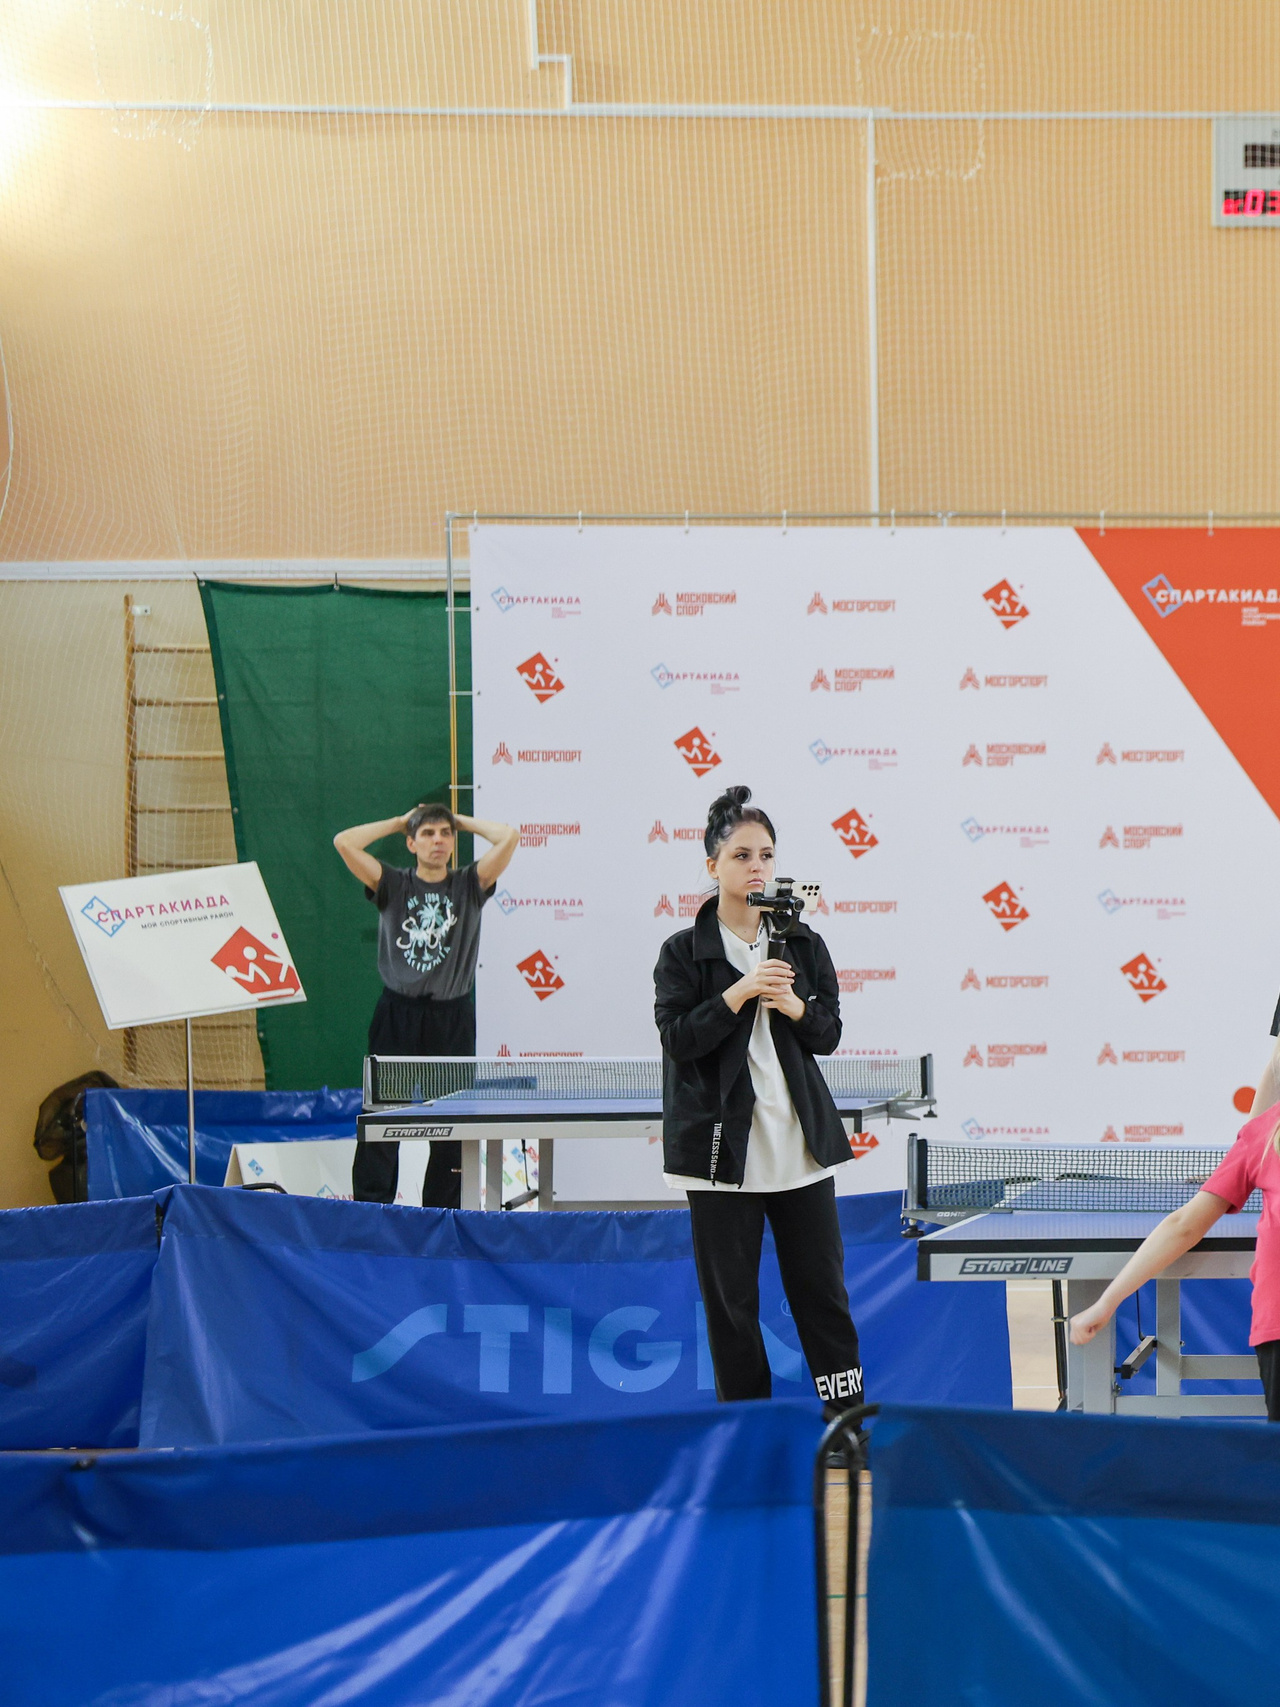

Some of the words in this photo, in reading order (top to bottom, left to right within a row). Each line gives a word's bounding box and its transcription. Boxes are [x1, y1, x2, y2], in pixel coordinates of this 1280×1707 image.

[499, 595, 581, 604] СПАРТАКИАДА
[676, 592, 736, 604] МОСКОВСКИЙ
[676, 604, 704, 616] СПОРТ
[832, 600, 896, 612] МОСГОРСПОРТ
[658, 672, 740, 681] СПАРТАКИАДА
[835, 667, 895, 680] МОСКОВСКИЙ
[835, 680, 862, 692] СПОРТ
[517, 750, 582, 762] МОСГОРСПОРТ
[816, 748, 898, 757] СПАРТАКИАДА
[520, 823, 581, 836] МОСКОВСКИЙ
[520, 836, 548, 847] СПОРТ
[97, 894, 230, 922] СПАРТАКИАДА
[502, 898, 584, 907] СПАРТАКИАДА
[834, 901, 898, 913] МОСГОРСПОРТ
[160, 916, 208, 927] СПОРТИВНЫЙ
[210, 911, 234, 920] РАЙОН
[385, 1128, 424, 1137] START
[426, 1128, 450, 1136] LINE
[712, 1122, 722, 1155] TIMELESS
[963, 1259, 1026, 1273] START
[1028, 1259, 1067, 1272] LINE
[815, 1366, 863, 1401] EVERY
